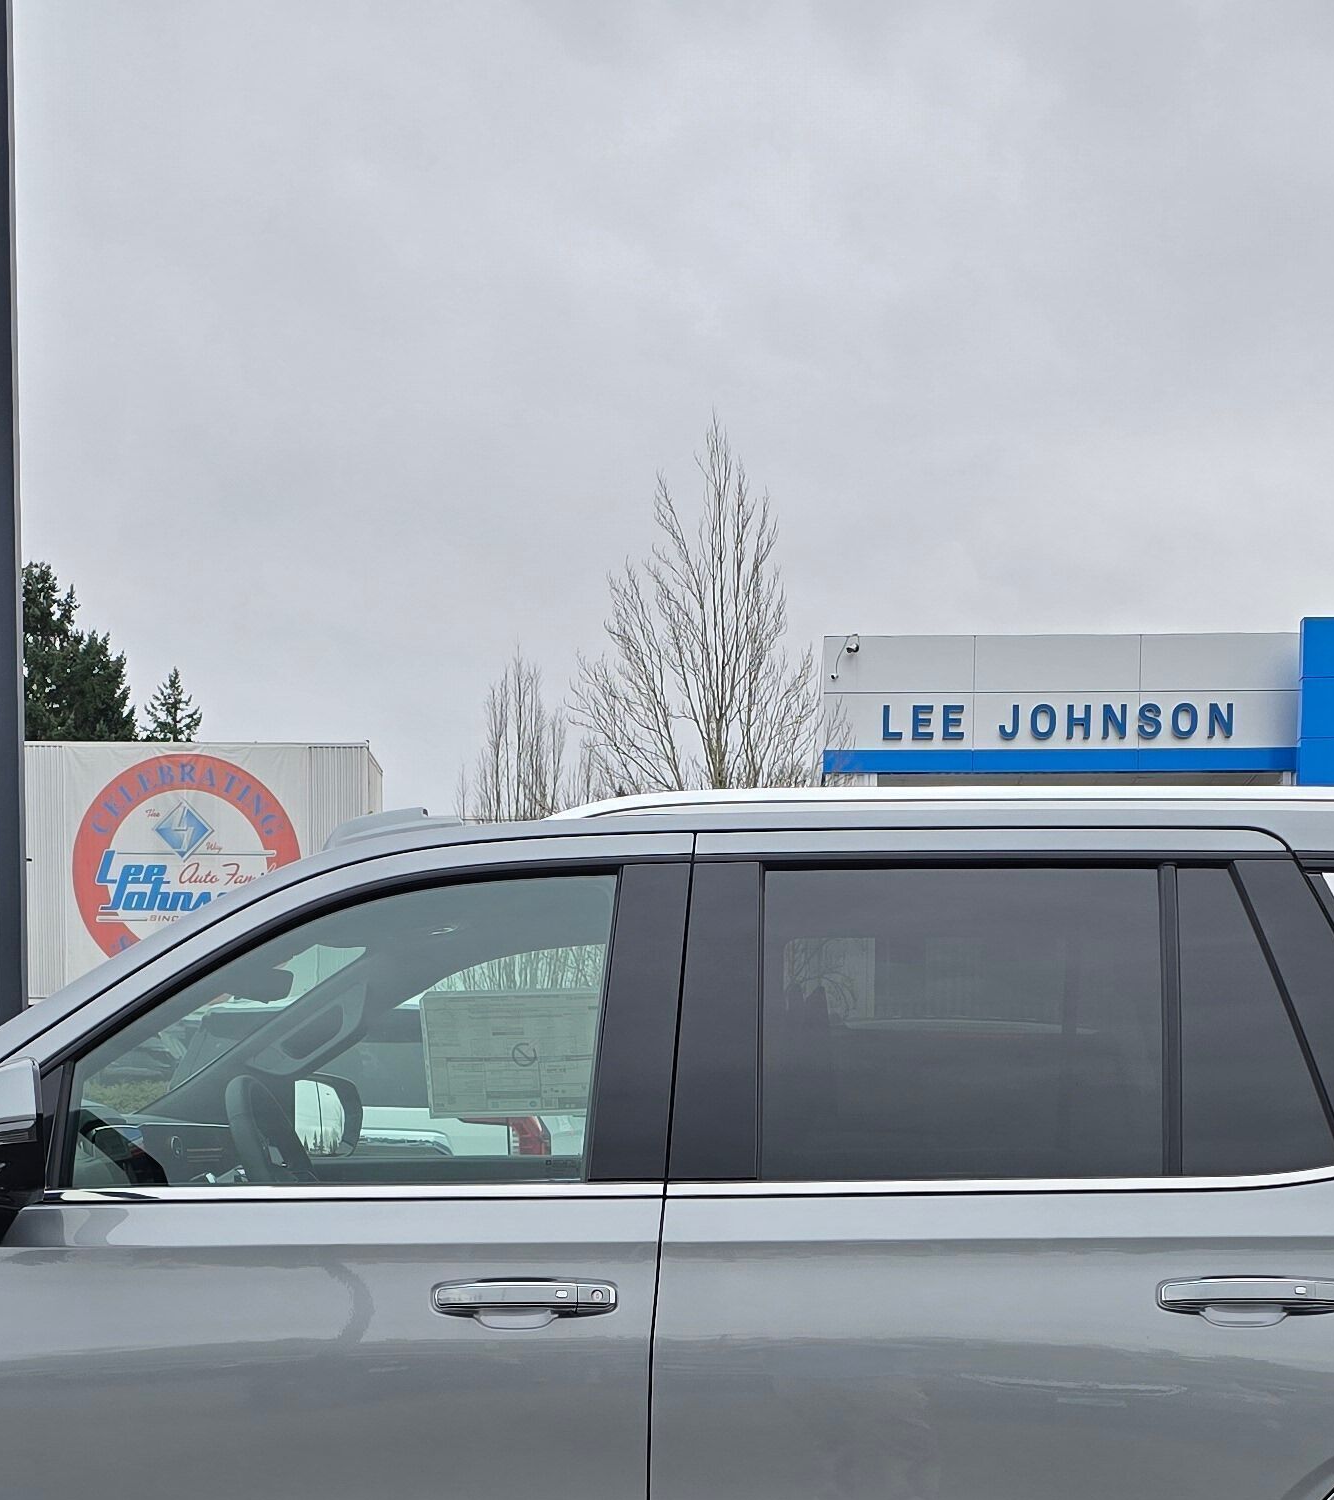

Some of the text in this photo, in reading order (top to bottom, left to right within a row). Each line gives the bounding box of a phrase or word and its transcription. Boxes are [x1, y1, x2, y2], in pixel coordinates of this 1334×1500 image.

[882, 702, 1234, 741] LEE JOHNSON
[91, 762, 284, 836] CELEBRATING
[145, 808, 160, 818] The
[96, 850, 170, 884] Lee
[178, 862, 276, 886] Auto Fam
[99, 873, 228, 912] Johns
